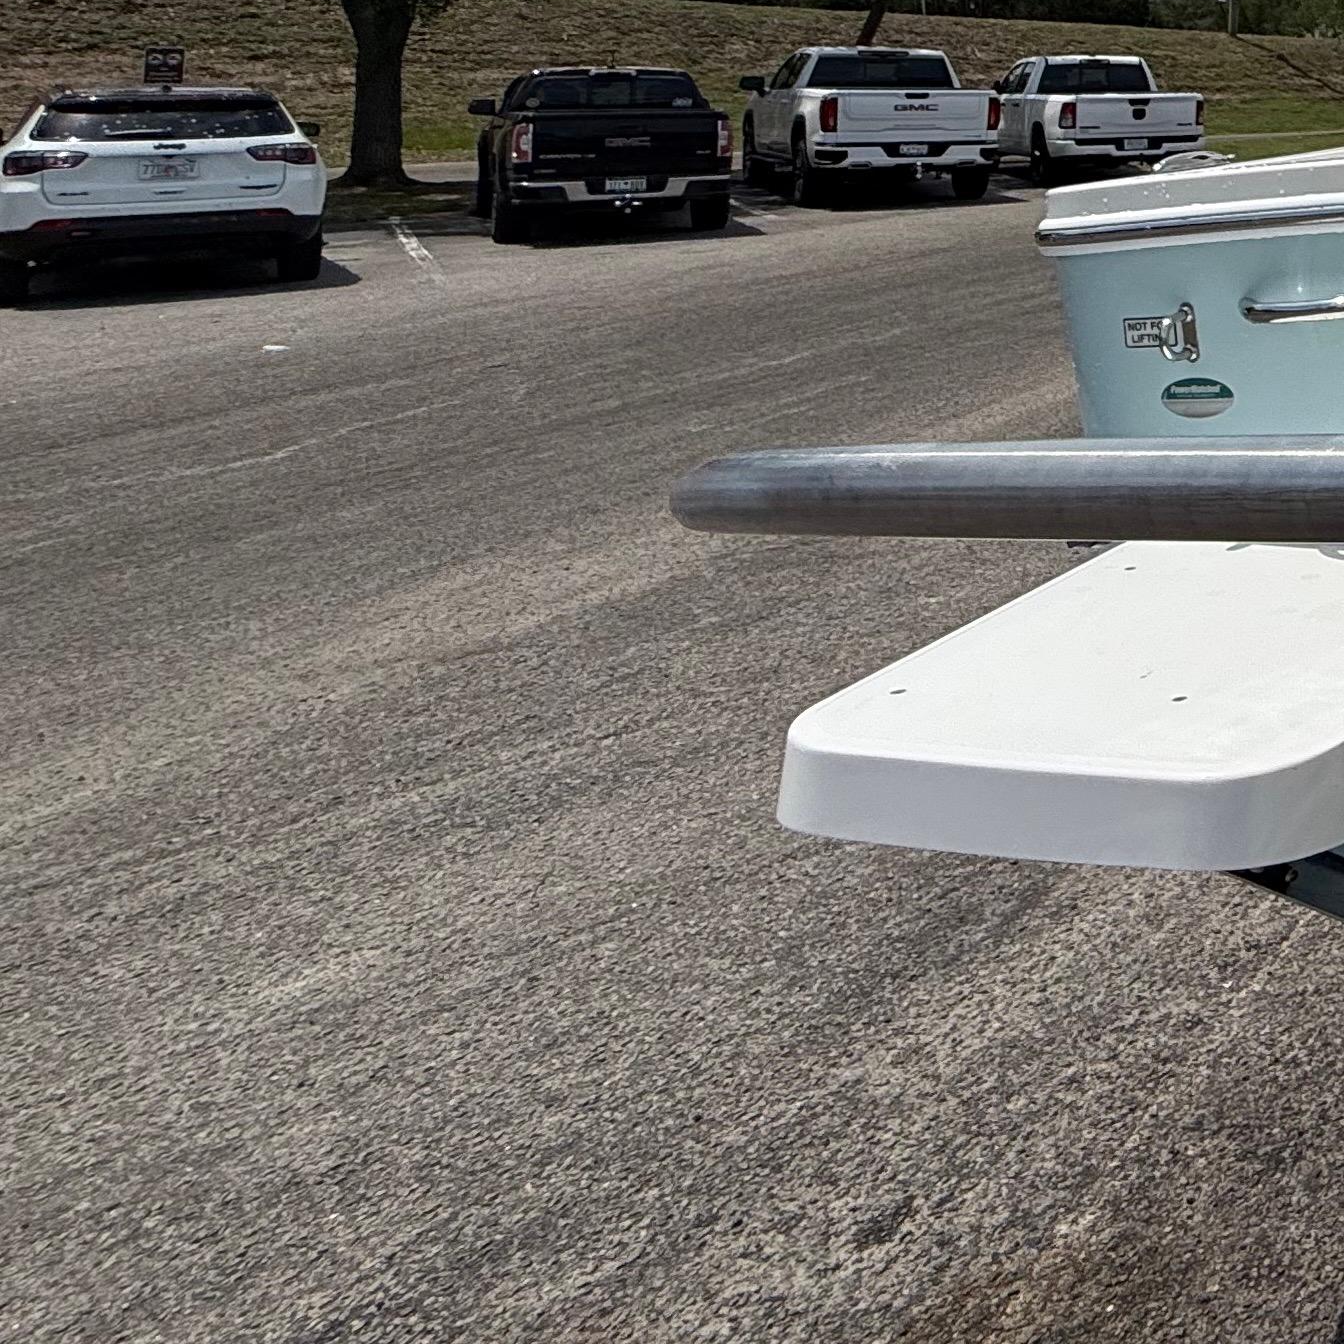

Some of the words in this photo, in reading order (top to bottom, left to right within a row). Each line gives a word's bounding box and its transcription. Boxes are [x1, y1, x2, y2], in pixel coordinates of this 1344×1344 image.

[893, 104, 940, 112] GMC
[604, 137, 651, 147] GMC
[1127, 321, 1148, 332] NOT
